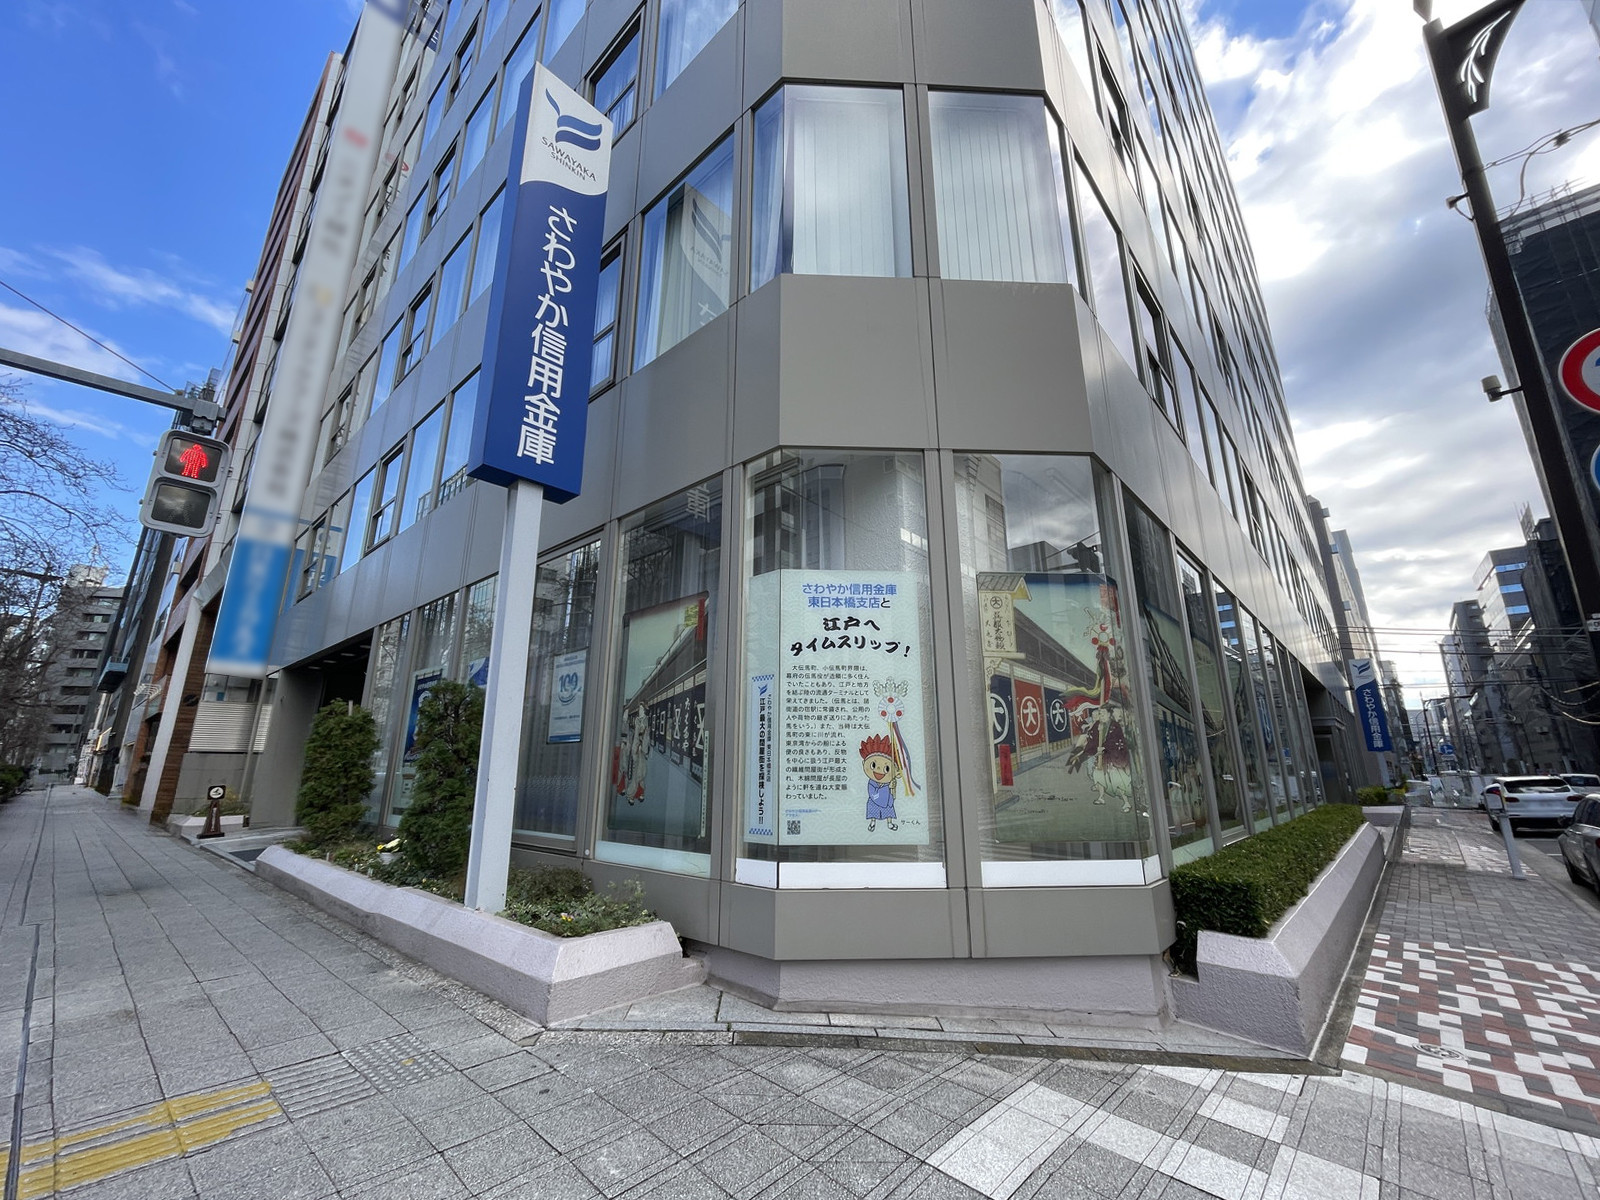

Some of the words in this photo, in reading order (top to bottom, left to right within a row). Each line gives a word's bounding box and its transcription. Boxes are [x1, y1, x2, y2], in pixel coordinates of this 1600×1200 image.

[541, 136, 597, 182] SAWAYAKA
[550, 151, 586, 181] SHINKIN
[516, 204, 578, 465] さわやか信用金庫
[802, 583, 897, 596] さわやか信用金庫
[808, 596, 891, 609] 東日本橋支店と
[822, 616, 881, 632] 江戸へ
[790, 635, 911, 658] タイムスリップ！
[1362, 688, 1384, 748] さわやか信用金庫
